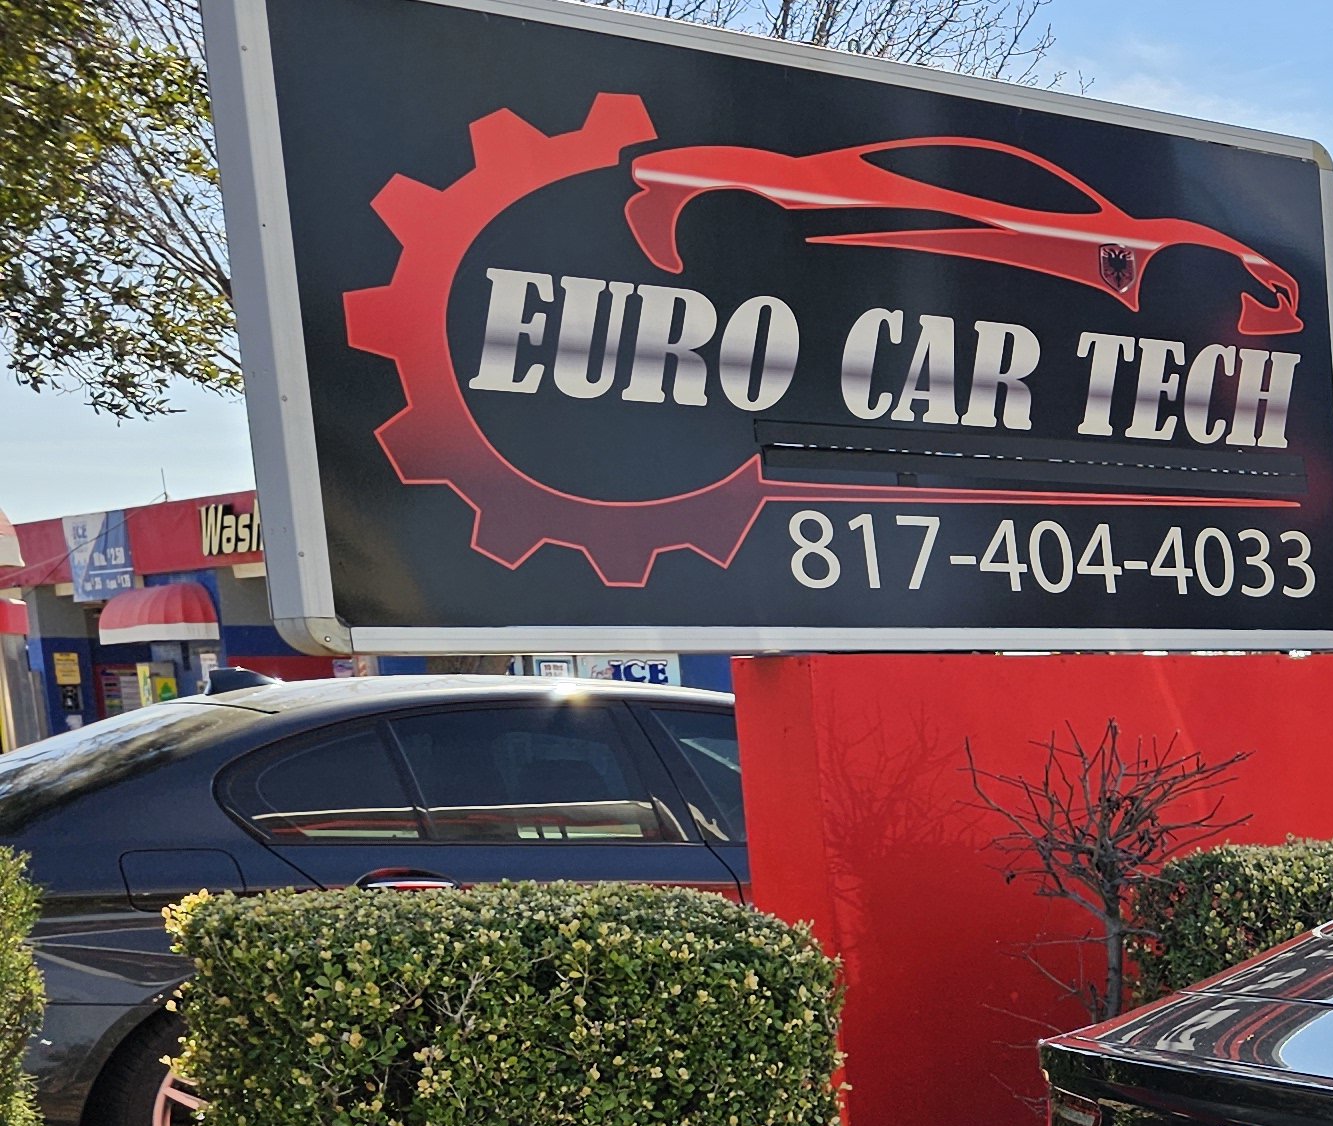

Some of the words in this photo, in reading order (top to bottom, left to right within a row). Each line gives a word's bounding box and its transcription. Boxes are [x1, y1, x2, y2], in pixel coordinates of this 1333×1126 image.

[468, 265, 801, 413] EURO
[839, 305, 1043, 432] CAR
[1075, 330, 1302, 449] TECH
[199, 499, 263, 557] Wash
[787, 509, 1317, 599] 817-404-4033
[608, 658, 669, 686] ICE
